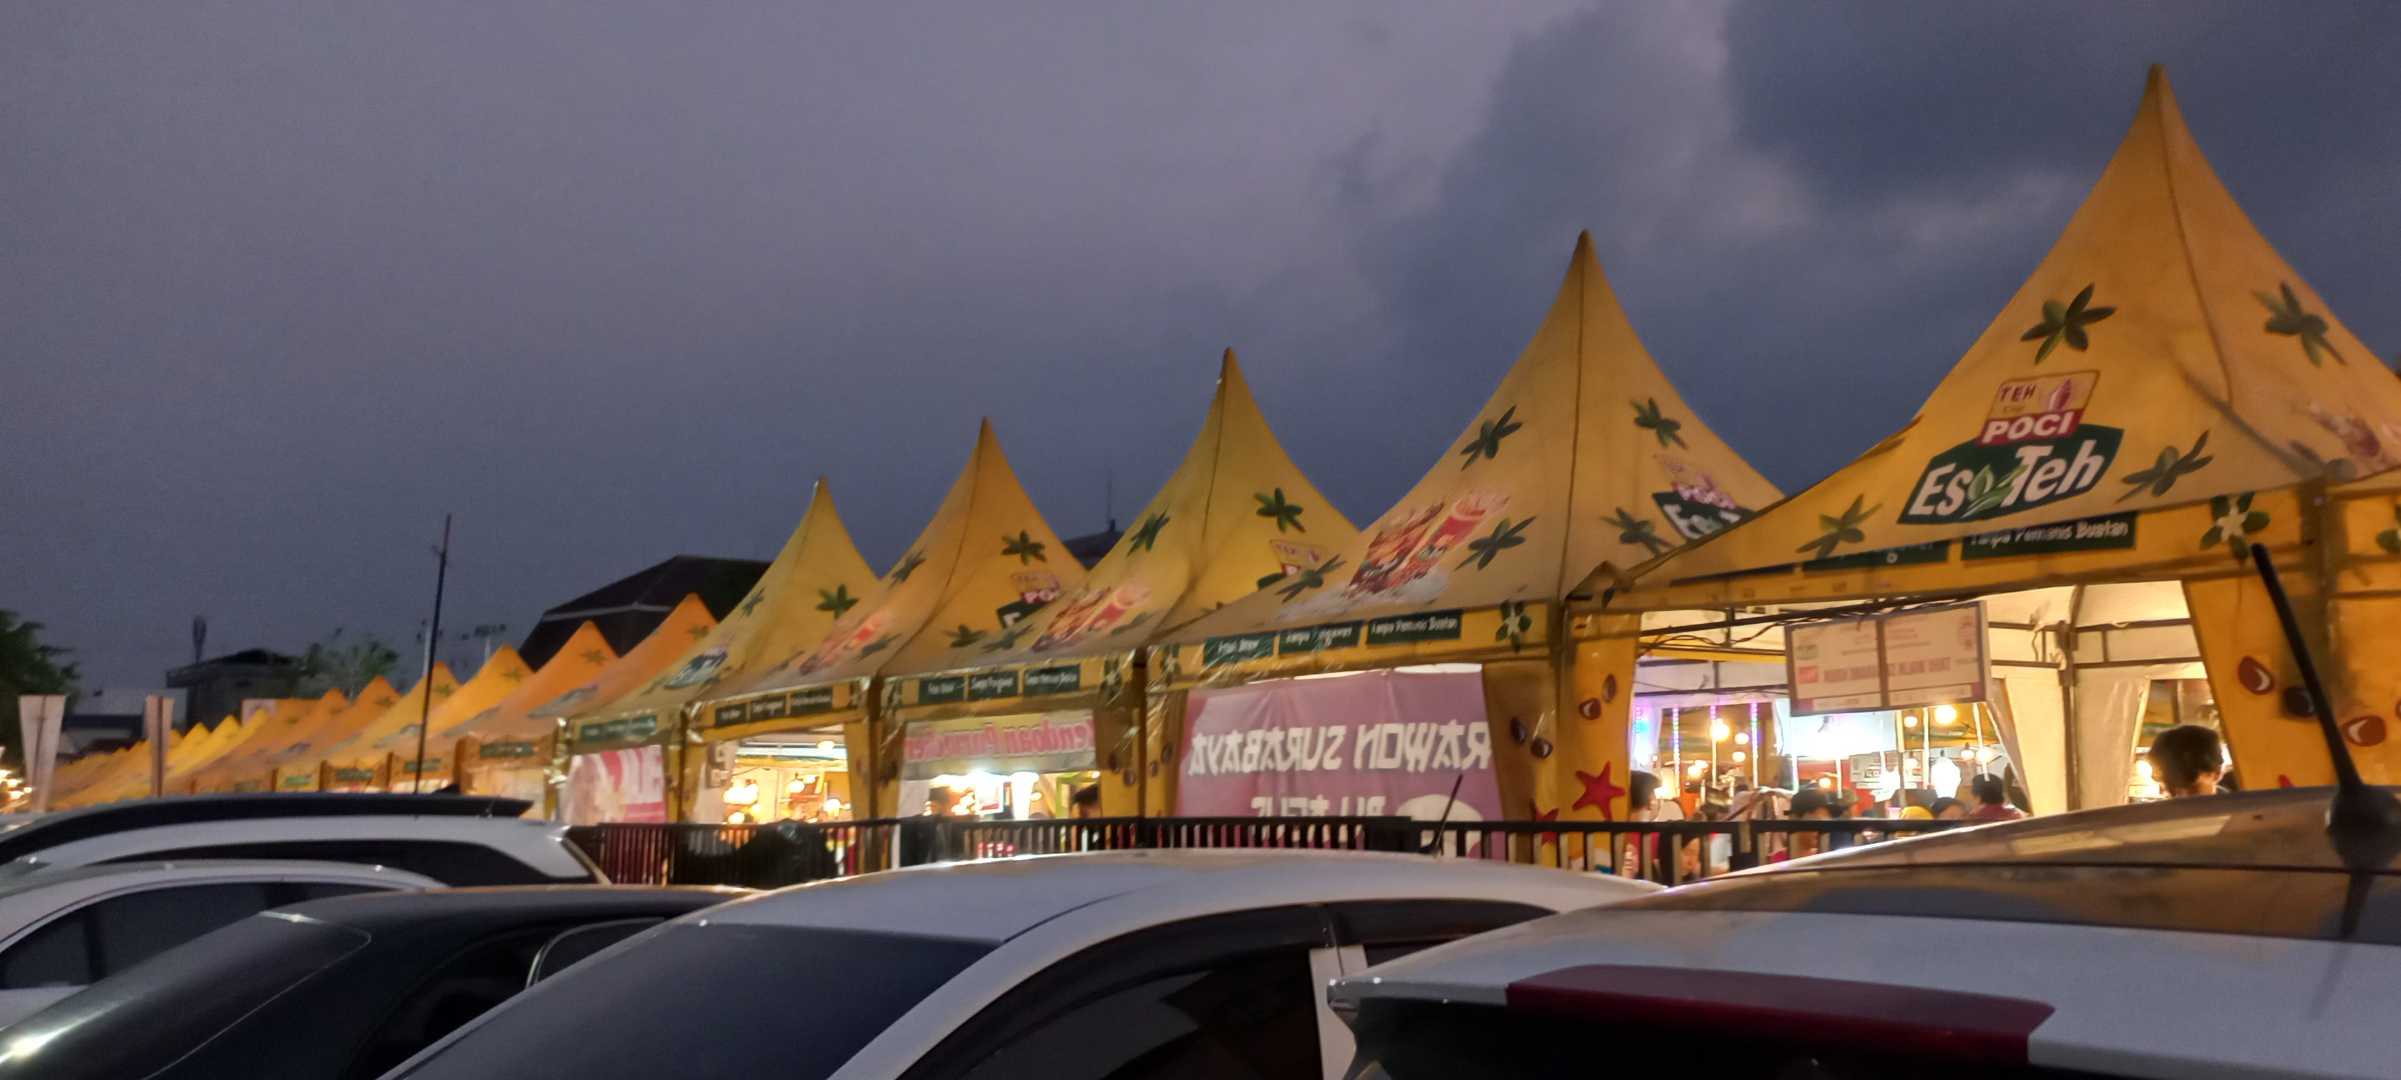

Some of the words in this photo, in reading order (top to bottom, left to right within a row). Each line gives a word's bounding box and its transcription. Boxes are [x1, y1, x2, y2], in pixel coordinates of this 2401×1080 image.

[2000, 384, 2037, 402] TEH
[1982, 411, 2071, 444] POCI
[1908, 463, 1973, 516] Es
[2001, 440, 2105, 507] Teh
